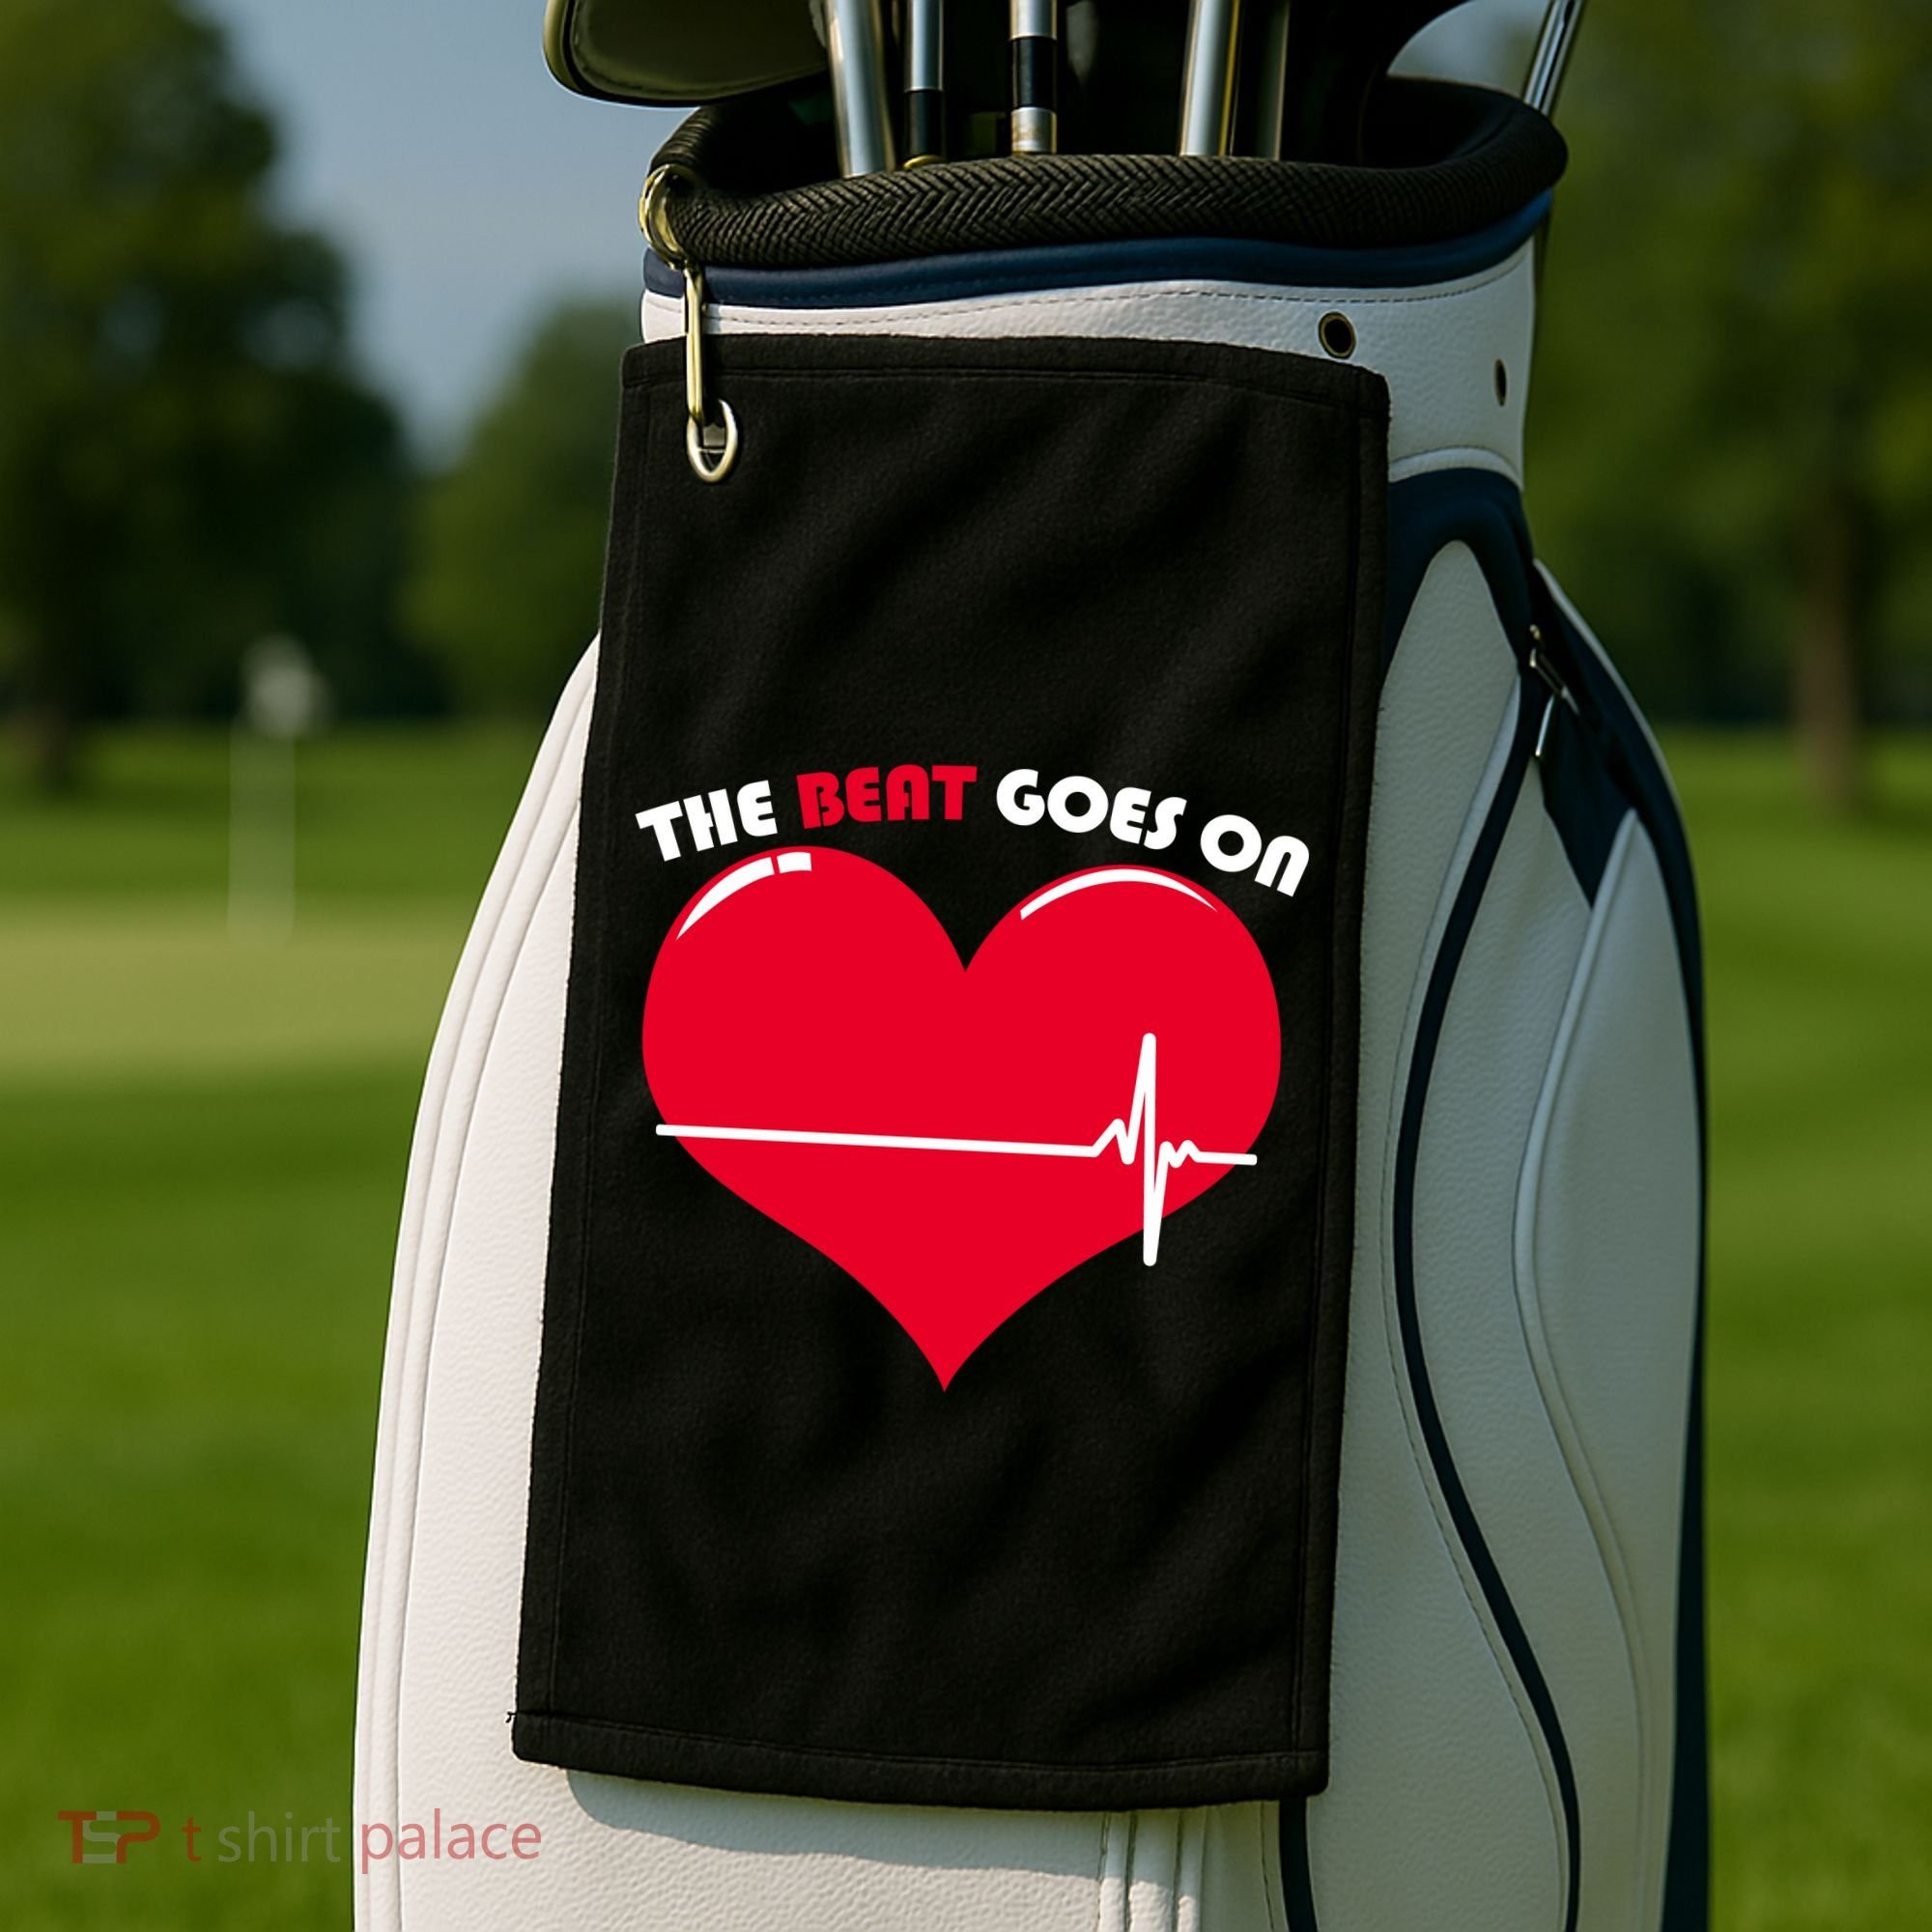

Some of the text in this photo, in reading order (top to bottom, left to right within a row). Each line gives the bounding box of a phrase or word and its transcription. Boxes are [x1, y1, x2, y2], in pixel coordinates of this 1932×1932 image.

[635, 764, 1310, 897] THE BEAT GOES ON
